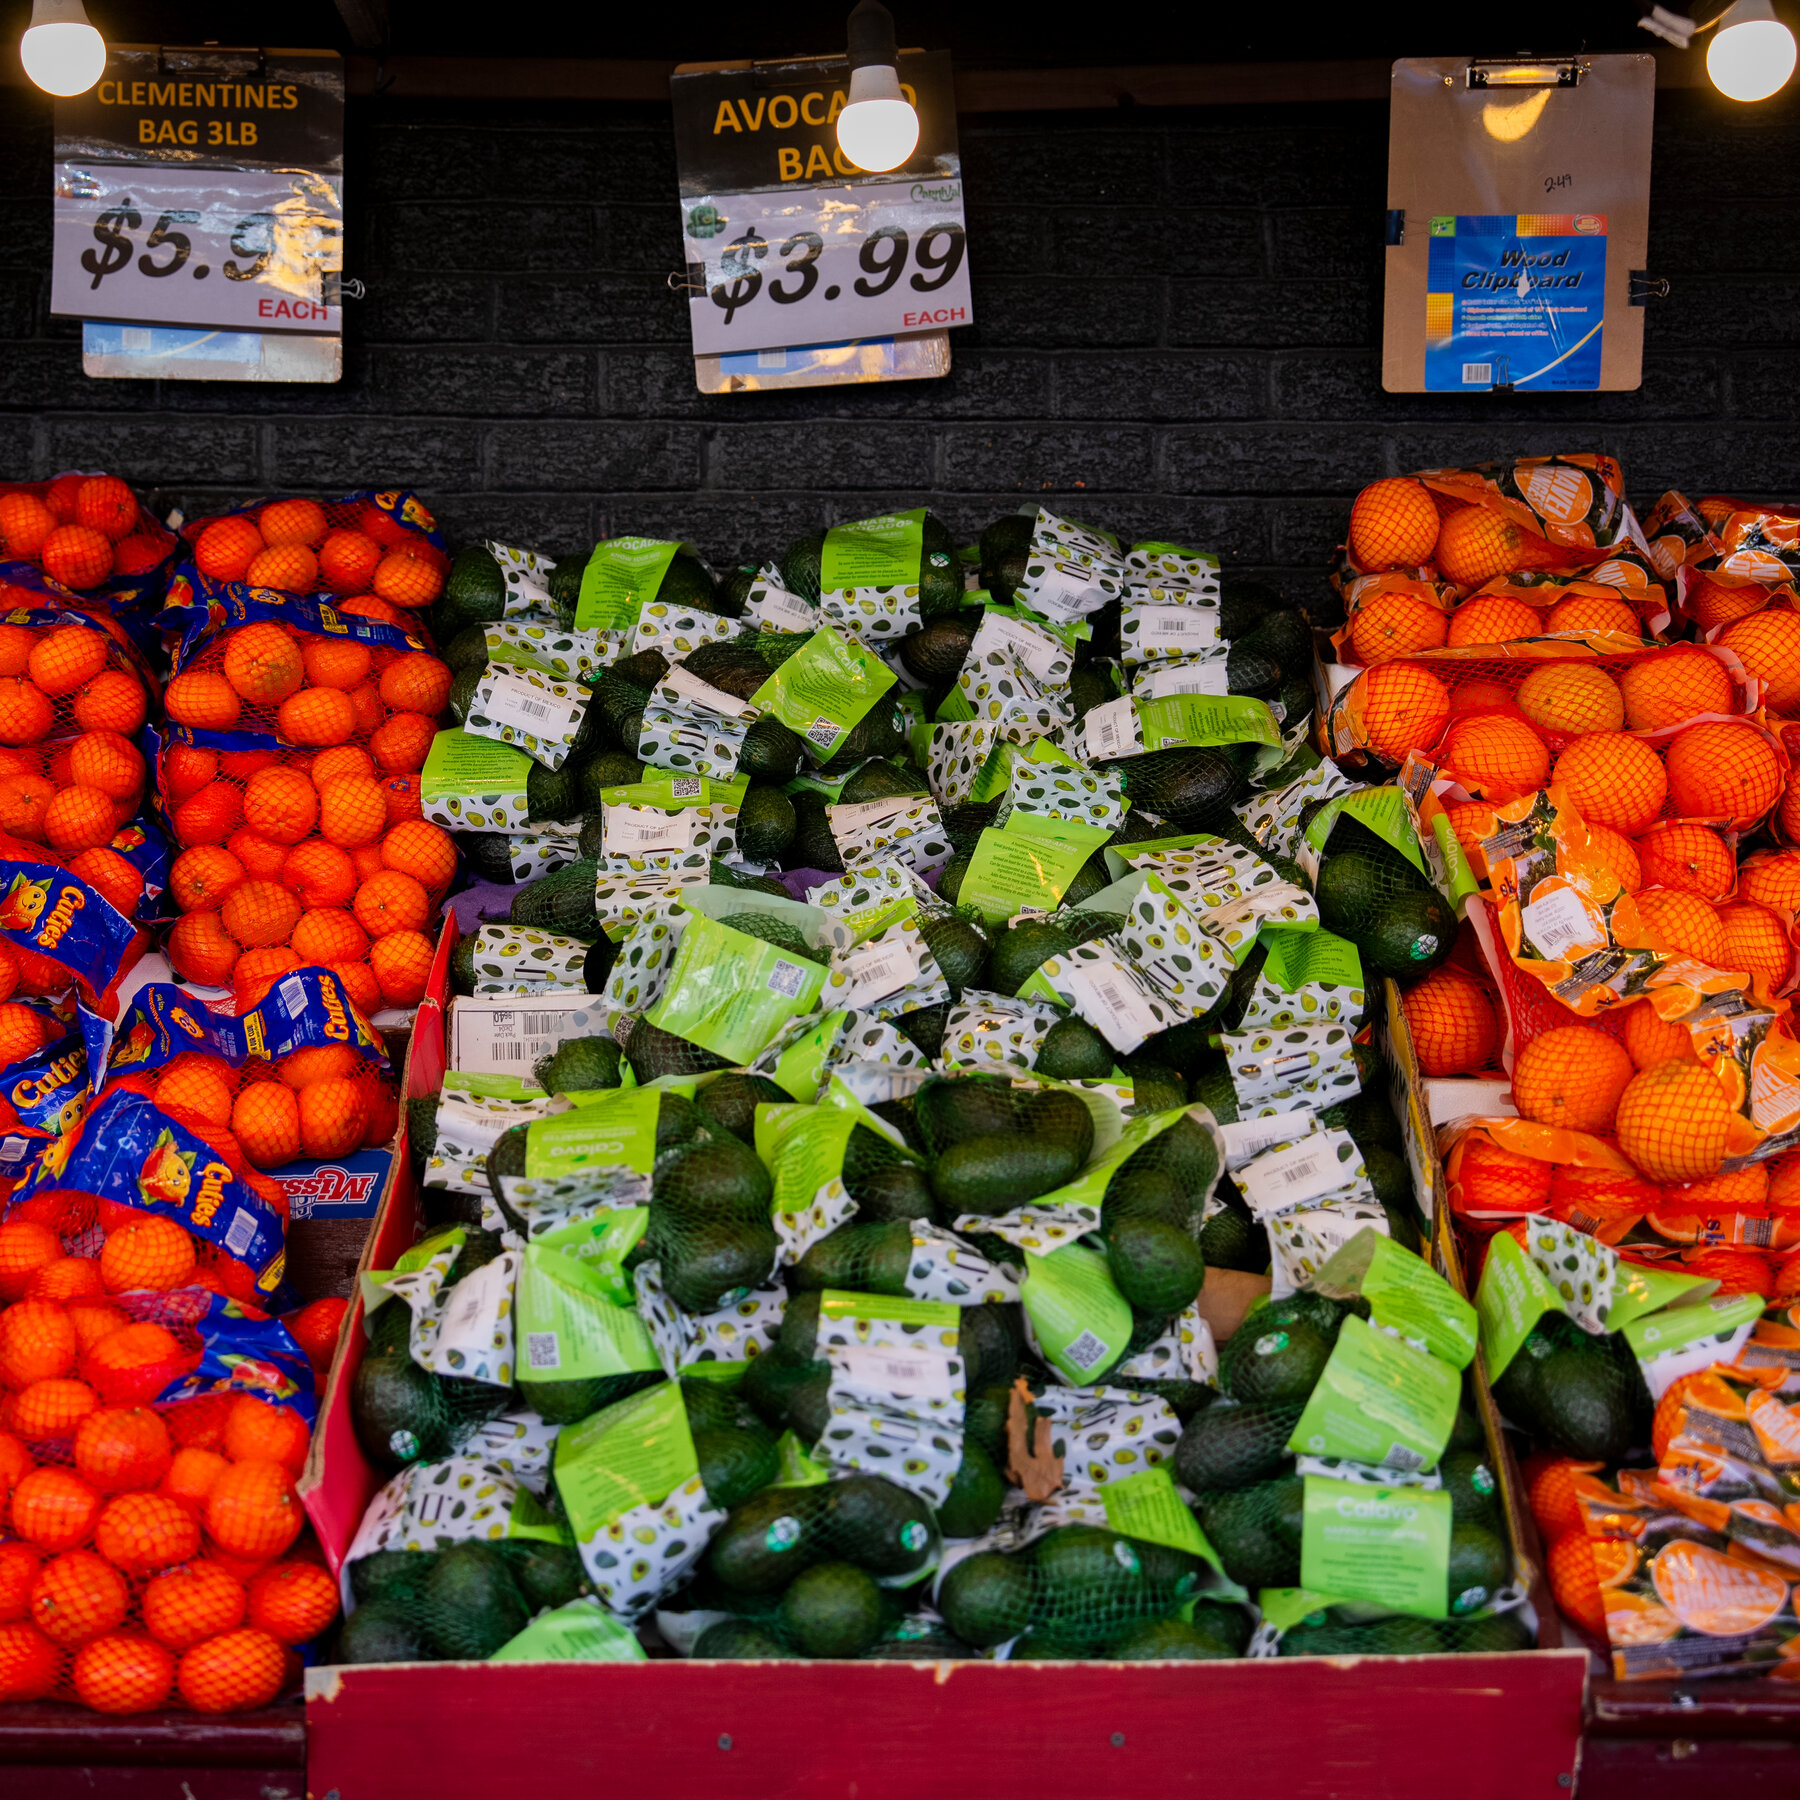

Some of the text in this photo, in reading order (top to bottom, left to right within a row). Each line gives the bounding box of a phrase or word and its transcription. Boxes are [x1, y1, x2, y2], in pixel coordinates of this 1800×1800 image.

[97, 80, 298, 110] CLEMENTINES
[712, 83, 918, 135] AVOCAO
[138, 119, 259, 146] BAG 3LB
[80, 197, 338, 290] $5.9
[1501, 249, 1571, 269] Wood
[711, 221, 966, 325] $3.99
[1461, 271, 1584, 294] Clipboard
[258, 299, 328, 321] EACH
[903, 307, 966, 327] EACH
[624, 821, 649, 829] PRODUCT
[37, 885, 86, 950] Cuties
[840, 899, 897, 925] alavo
[322, 974, 351, 1042] Cuties
[550, 1141, 625, 1157] Calavo
[190, 1161, 234, 1228] Cuties
[272, 1166, 374, 1204] Miss
[1335, 1495, 1419, 1521] Calavo
